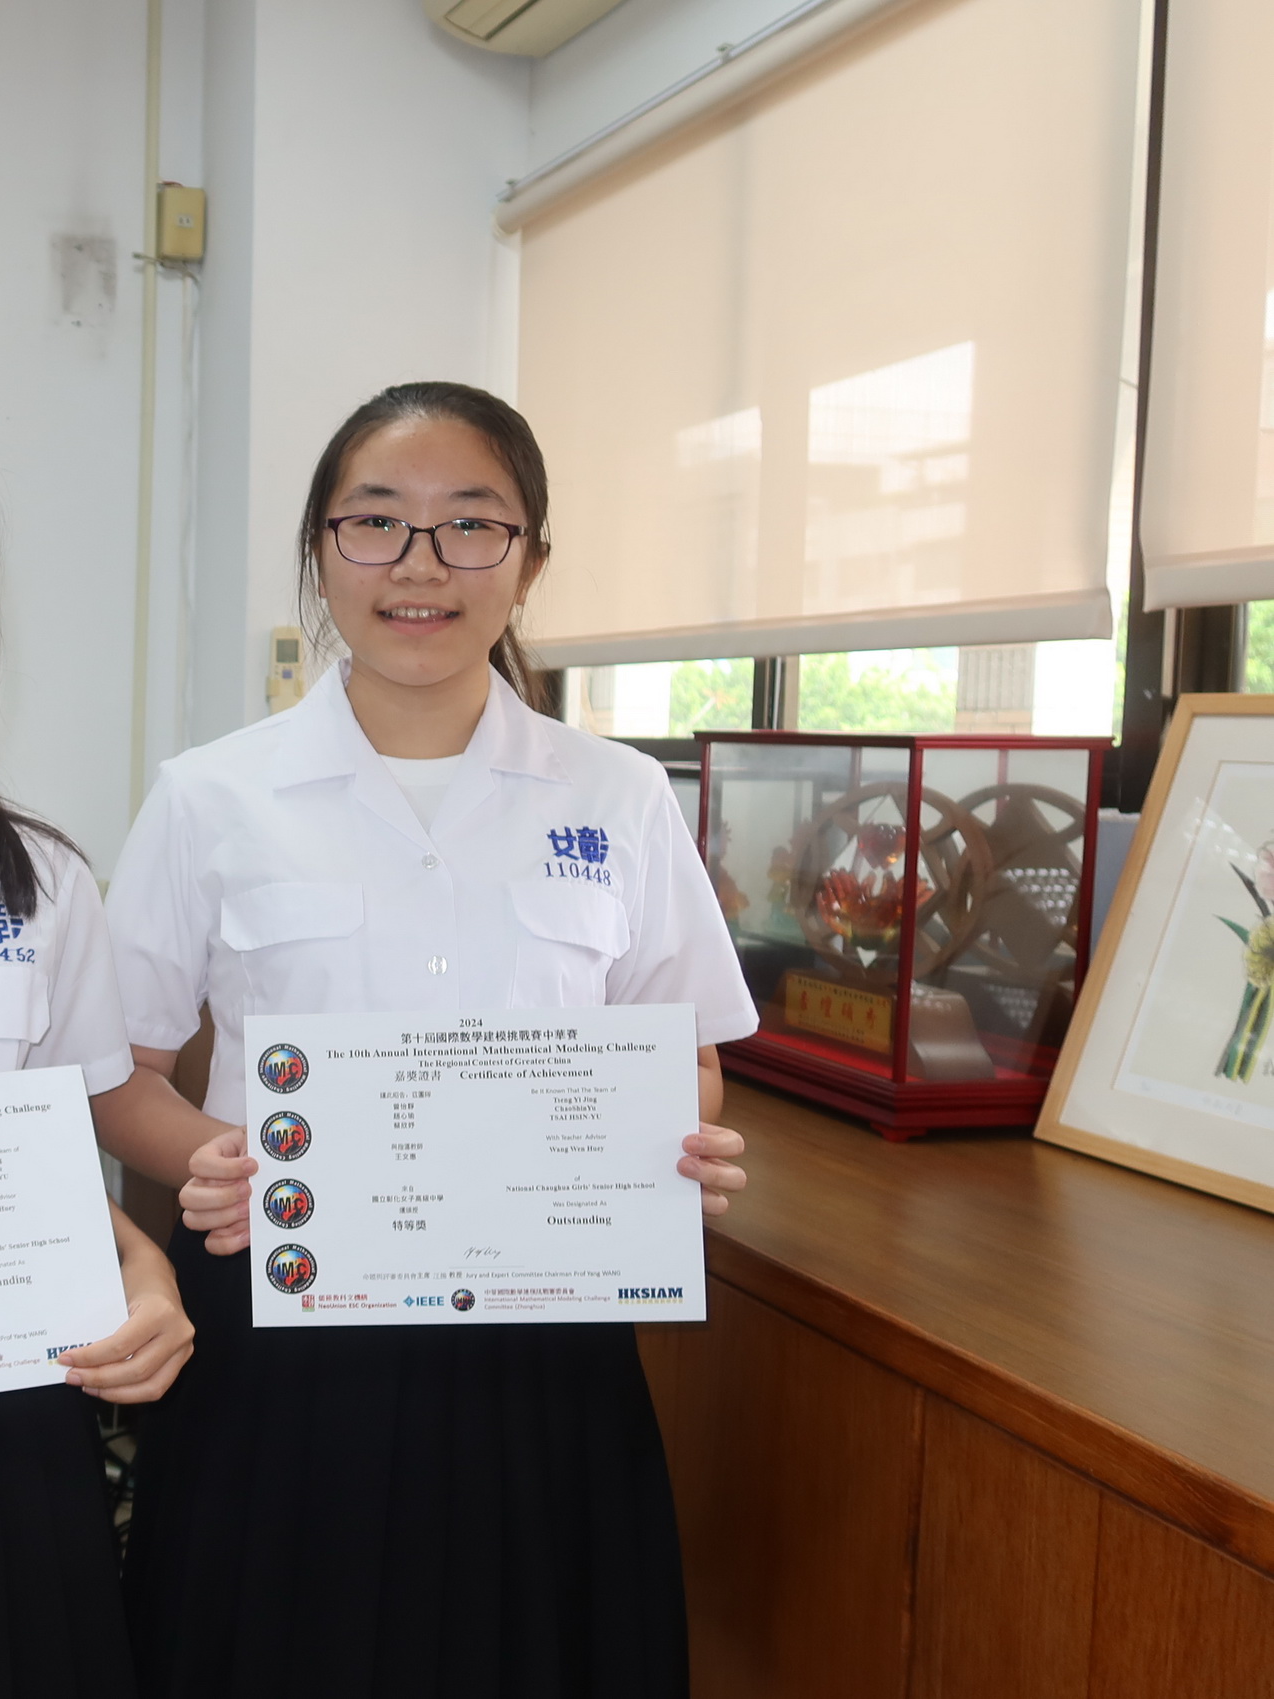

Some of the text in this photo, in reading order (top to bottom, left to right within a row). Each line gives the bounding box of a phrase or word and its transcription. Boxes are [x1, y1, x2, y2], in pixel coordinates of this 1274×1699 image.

[544, 861, 611, 887] 110448
[459, 1018, 482, 1027] 2024
[326, 1041, 656, 1058] The 10th Annual International Mathematical Modeling Challenge
[418, 1056, 571, 1068] The Regional Contest of Greater China
[460, 1067, 593, 1079] Certificate of Achievement
[4, 1100, 51, 1115] Challenge
[547, 1214, 611, 1227] Outstanding
[617, 1287, 682, 1299] HKSIAM
[416, 1296, 444, 1306] IEEE
